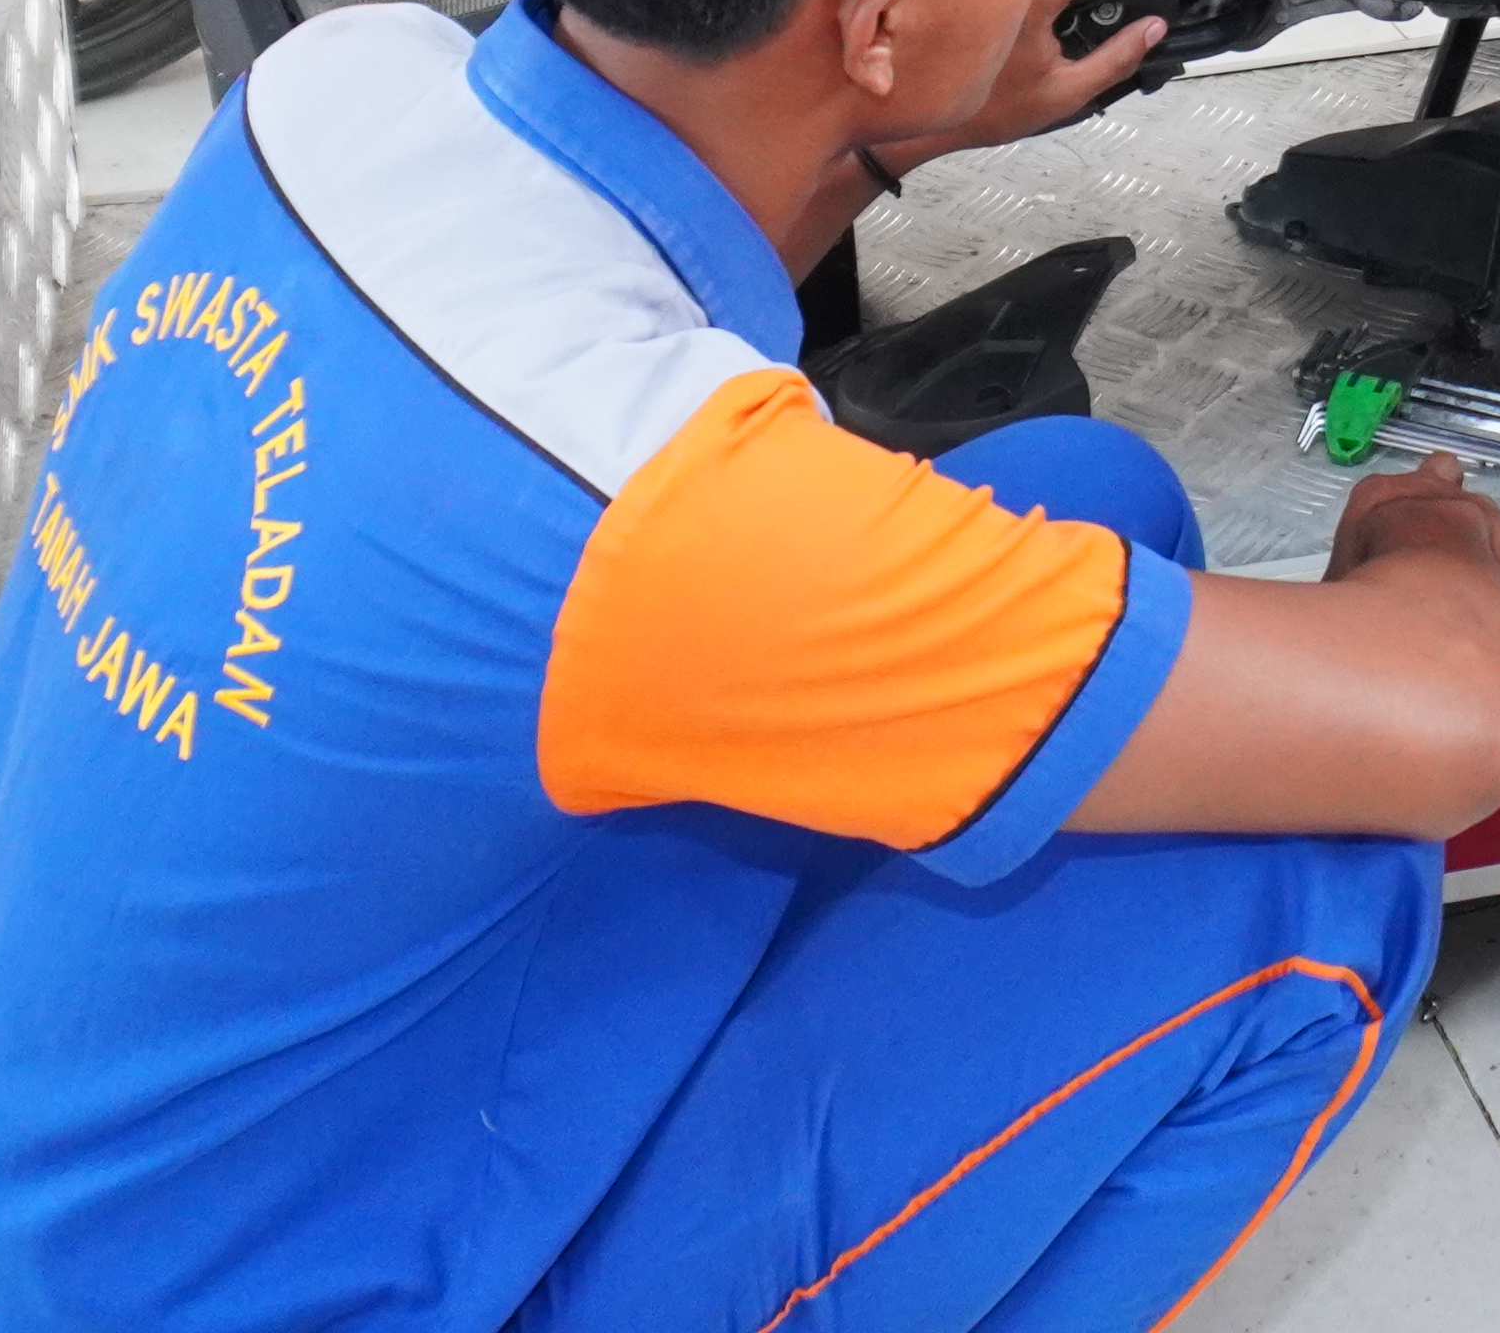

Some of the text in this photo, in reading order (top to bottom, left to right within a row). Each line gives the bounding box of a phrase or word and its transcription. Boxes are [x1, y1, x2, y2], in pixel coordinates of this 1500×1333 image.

[31, 471, 198, 761] TANAH JAWA
[51, 271, 309, 729] SMK SWASTA TELADAN
